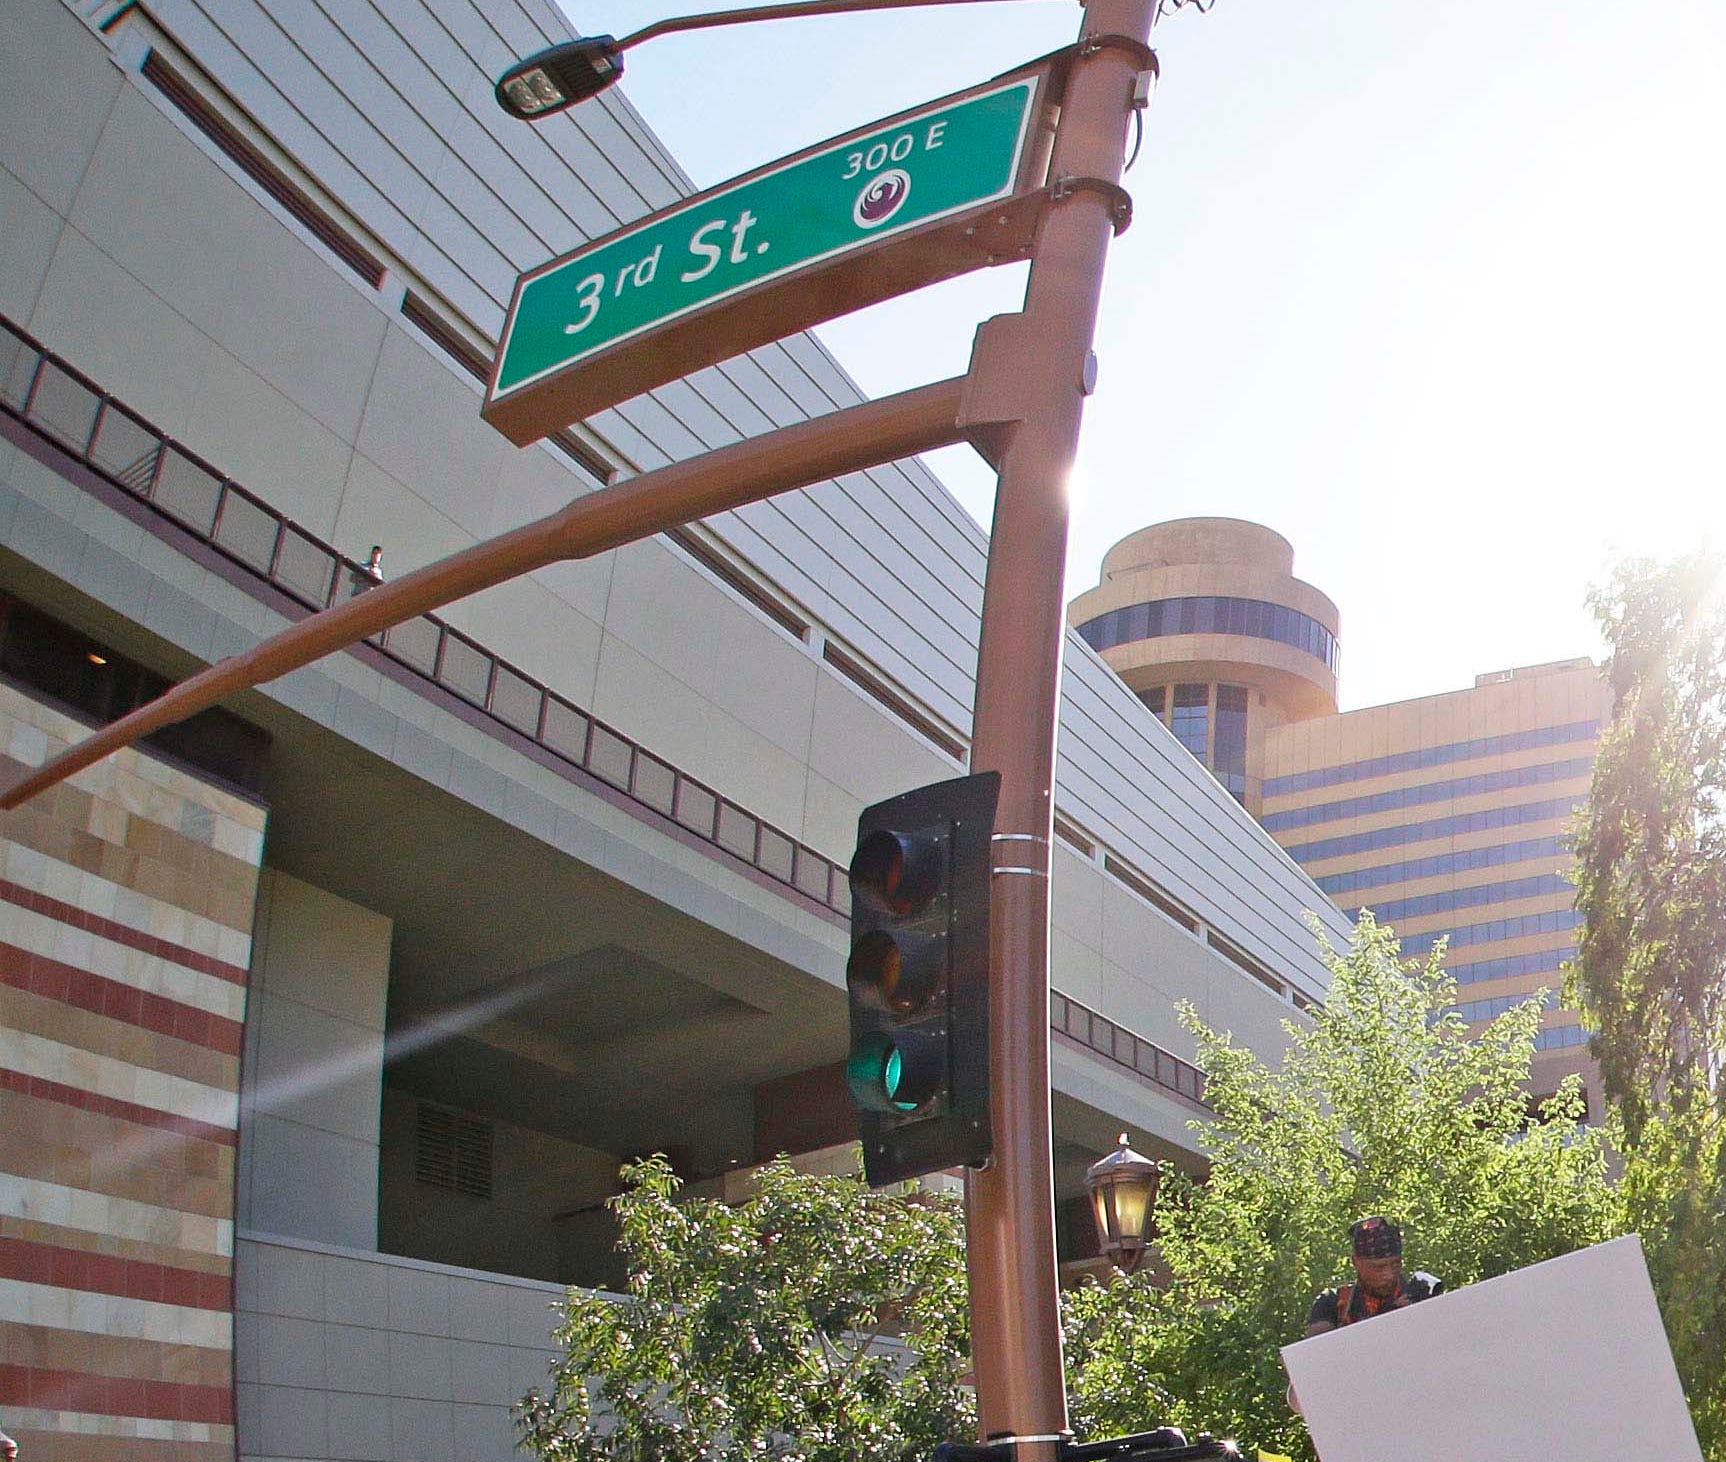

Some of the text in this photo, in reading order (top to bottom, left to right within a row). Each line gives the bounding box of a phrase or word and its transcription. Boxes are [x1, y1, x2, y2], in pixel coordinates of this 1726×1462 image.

[842, 120, 949, 181] 300 E
[563, 209, 770, 335] 3rd St.
